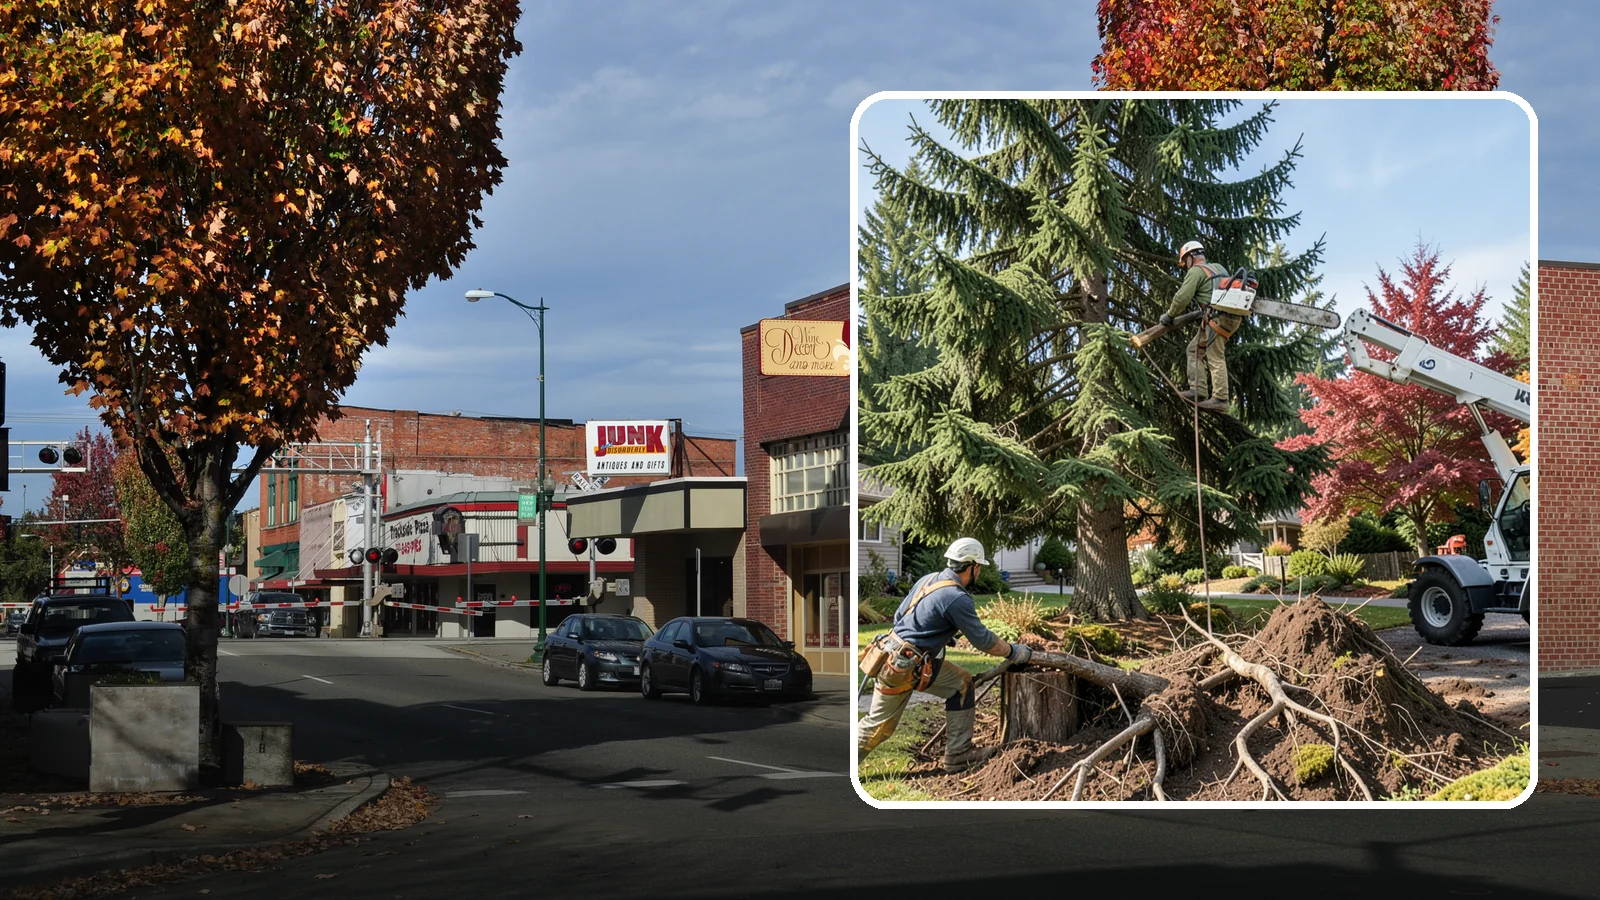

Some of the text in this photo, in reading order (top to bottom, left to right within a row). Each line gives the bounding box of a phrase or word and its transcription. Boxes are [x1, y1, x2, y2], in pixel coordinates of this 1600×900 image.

[596, 426, 664, 456] JUNK
[607, 446, 646, 454] DISORDERLY
[596, 460, 665, 470] ANTIQUES AND GIFTS
[588, 476, 608, 492] SING
[352, 498, 365, 511] CRO
[390, 519, 429, 540] Trackside Pizza
